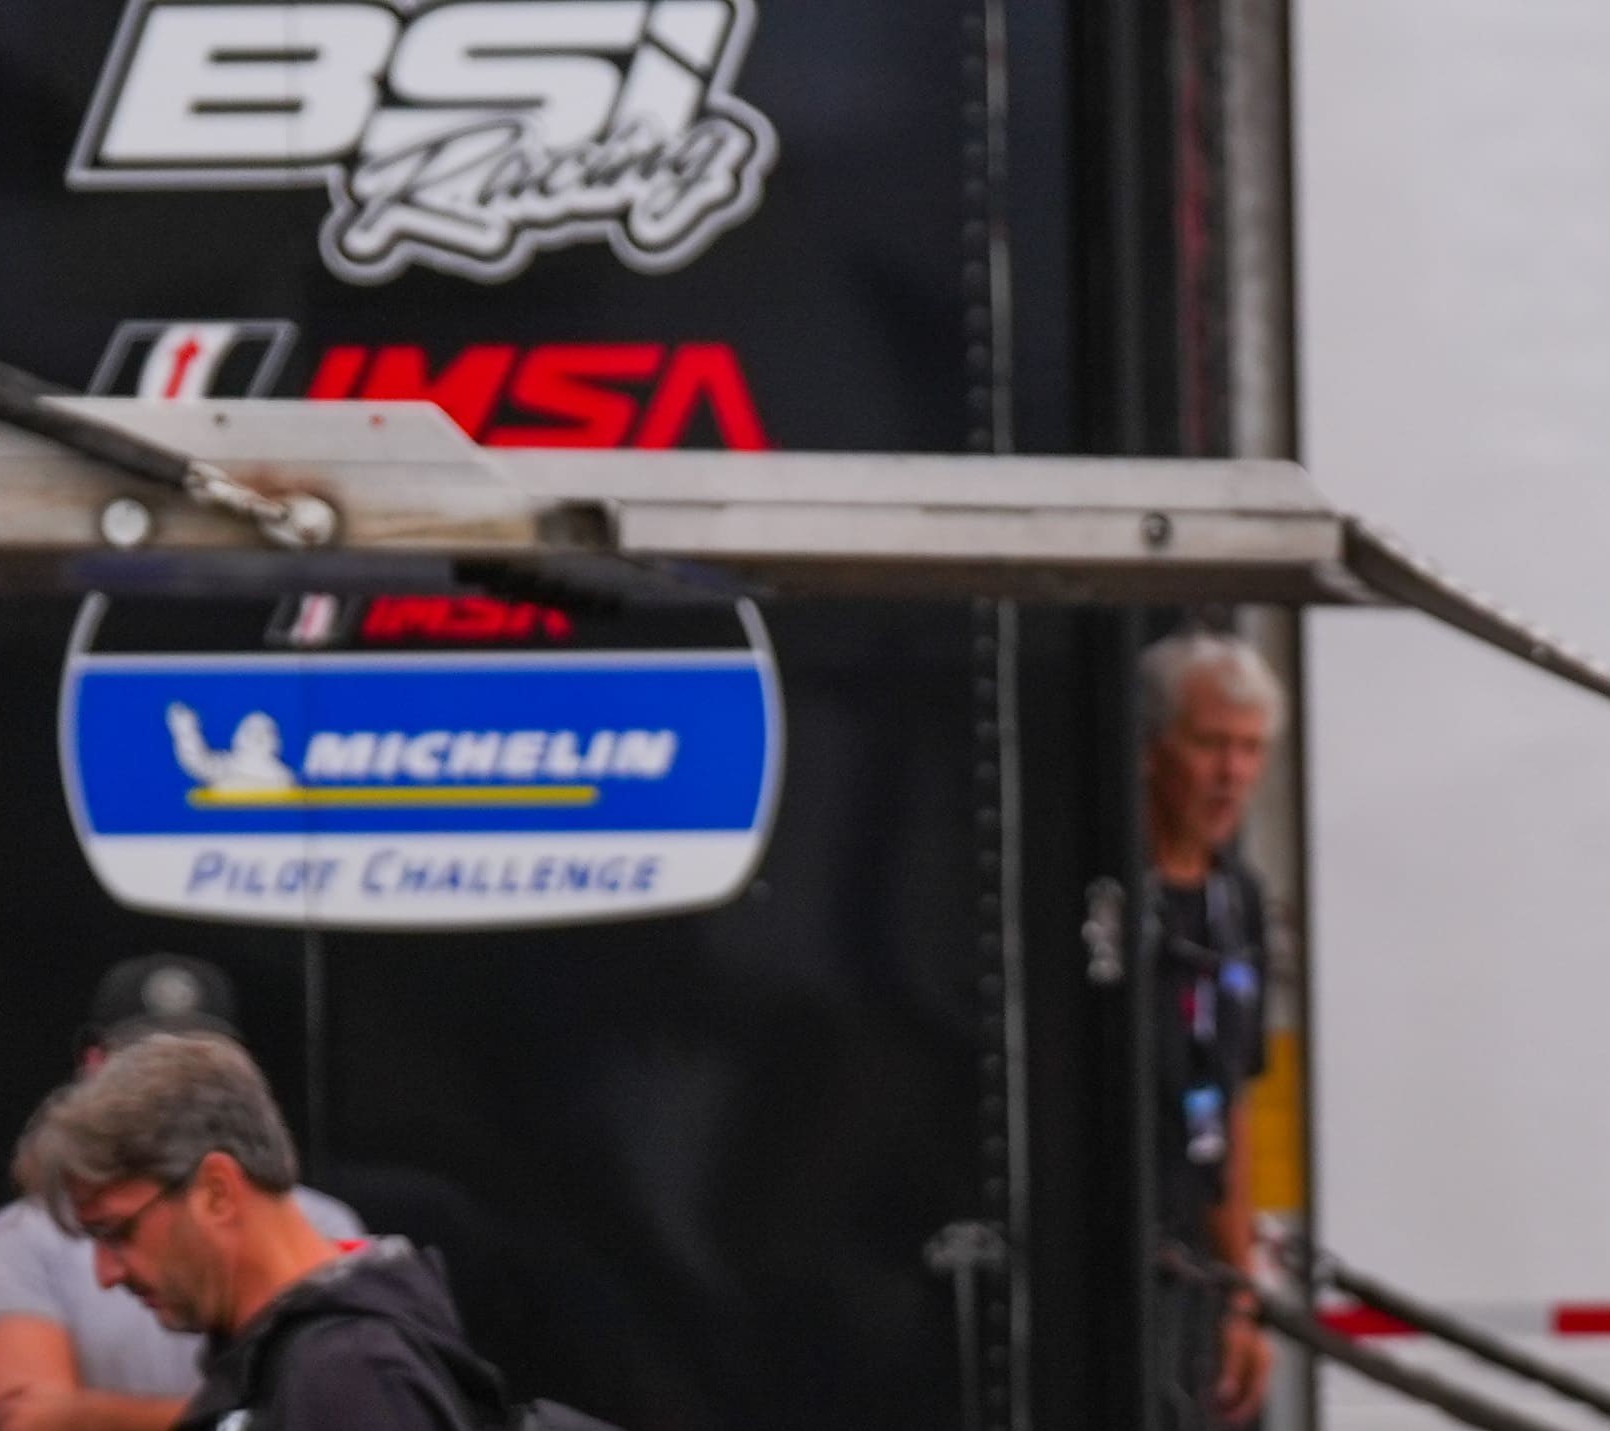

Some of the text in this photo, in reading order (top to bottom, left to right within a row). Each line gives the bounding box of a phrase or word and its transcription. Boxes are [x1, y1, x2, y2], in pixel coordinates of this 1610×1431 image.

[304, 730, 679, 780] MICHELIN
[188, 850, 663, 896] PILOT CHALLENGE
